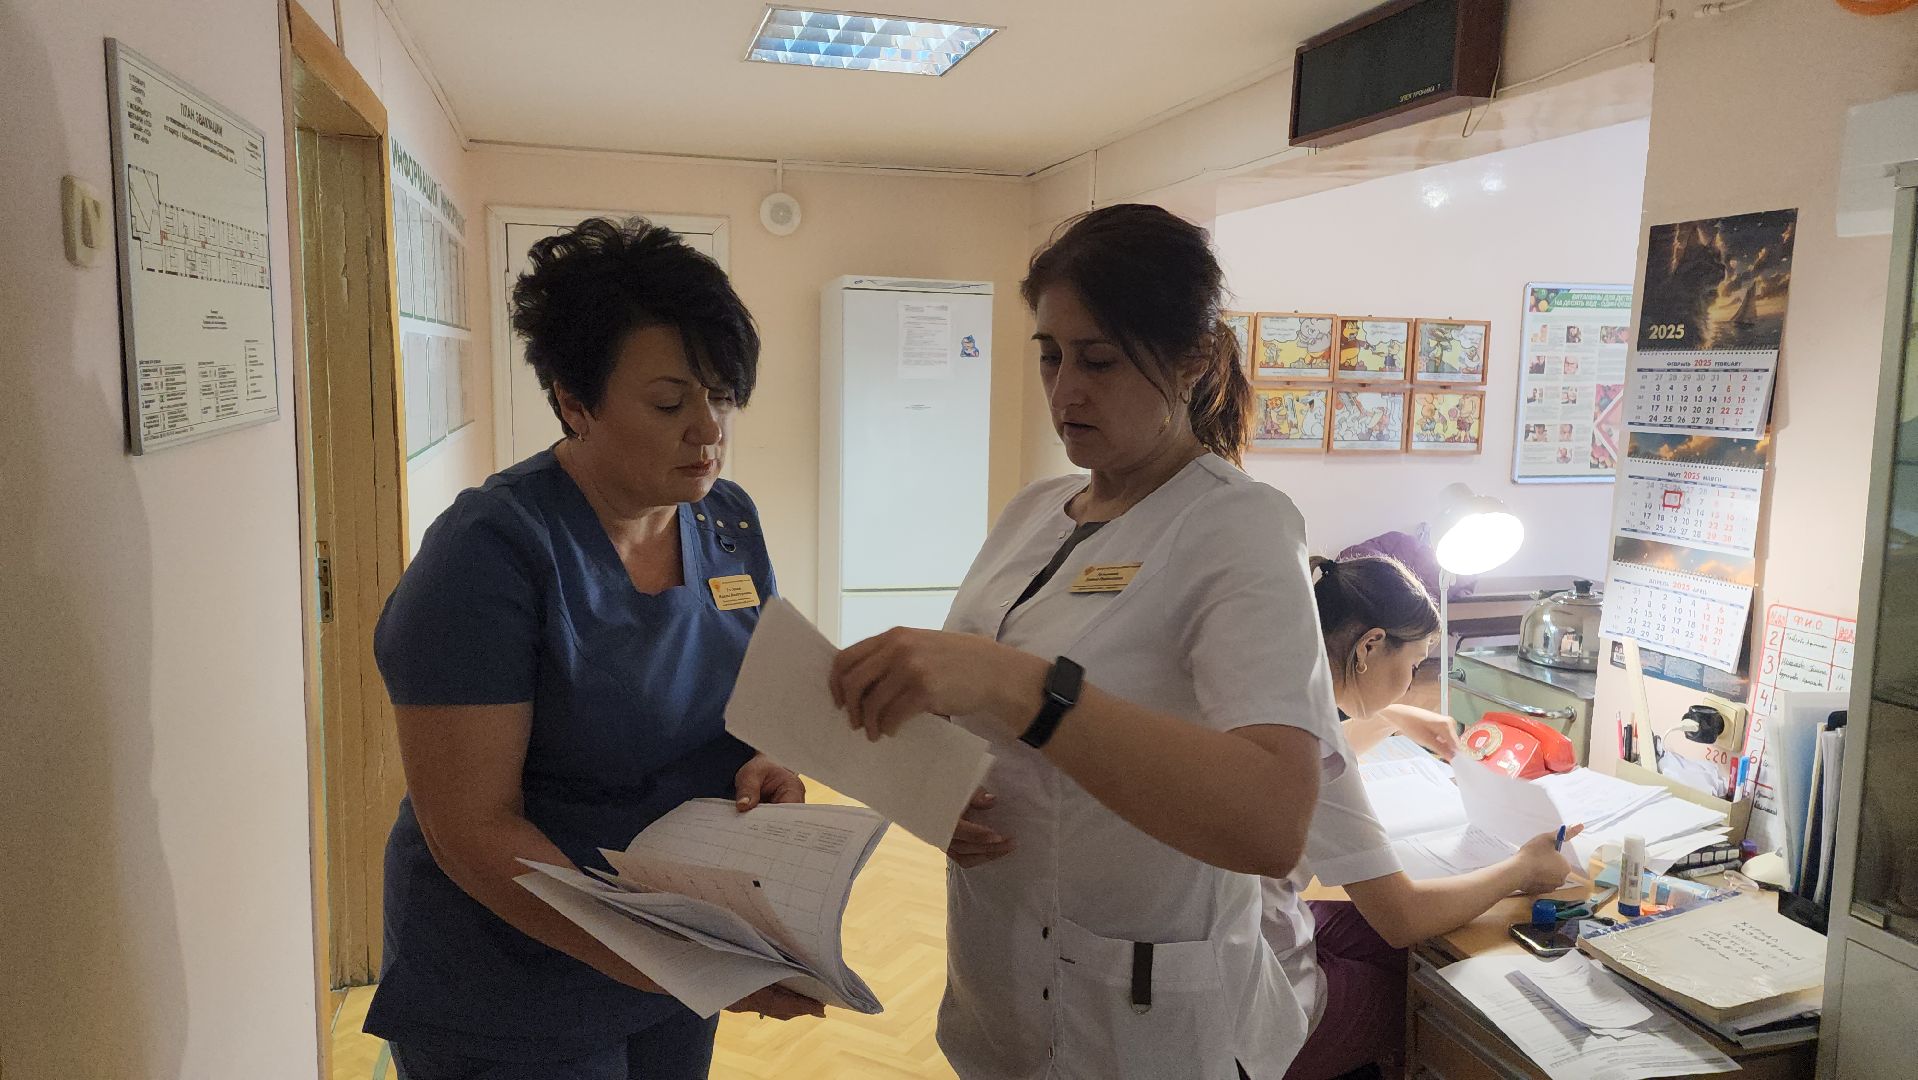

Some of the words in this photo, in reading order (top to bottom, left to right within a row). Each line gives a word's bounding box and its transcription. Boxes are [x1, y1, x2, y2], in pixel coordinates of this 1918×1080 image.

[1650, 324, 1685, 340] 2025
[1683, 471, 1700, 479] 2025
[1672, 580, 1691, 591] 2025
[1685, 630, 1694, 638] 25
[1769, 631, 1778, 645] 2
[1763, 655, 1774, 675] 3
[1760, 690, 1768, 706] 4
[1754, 719, 1762, 732] 5
[1706, 748, 1727, 764] 220
[1750, 750, 1757, 763] 6
